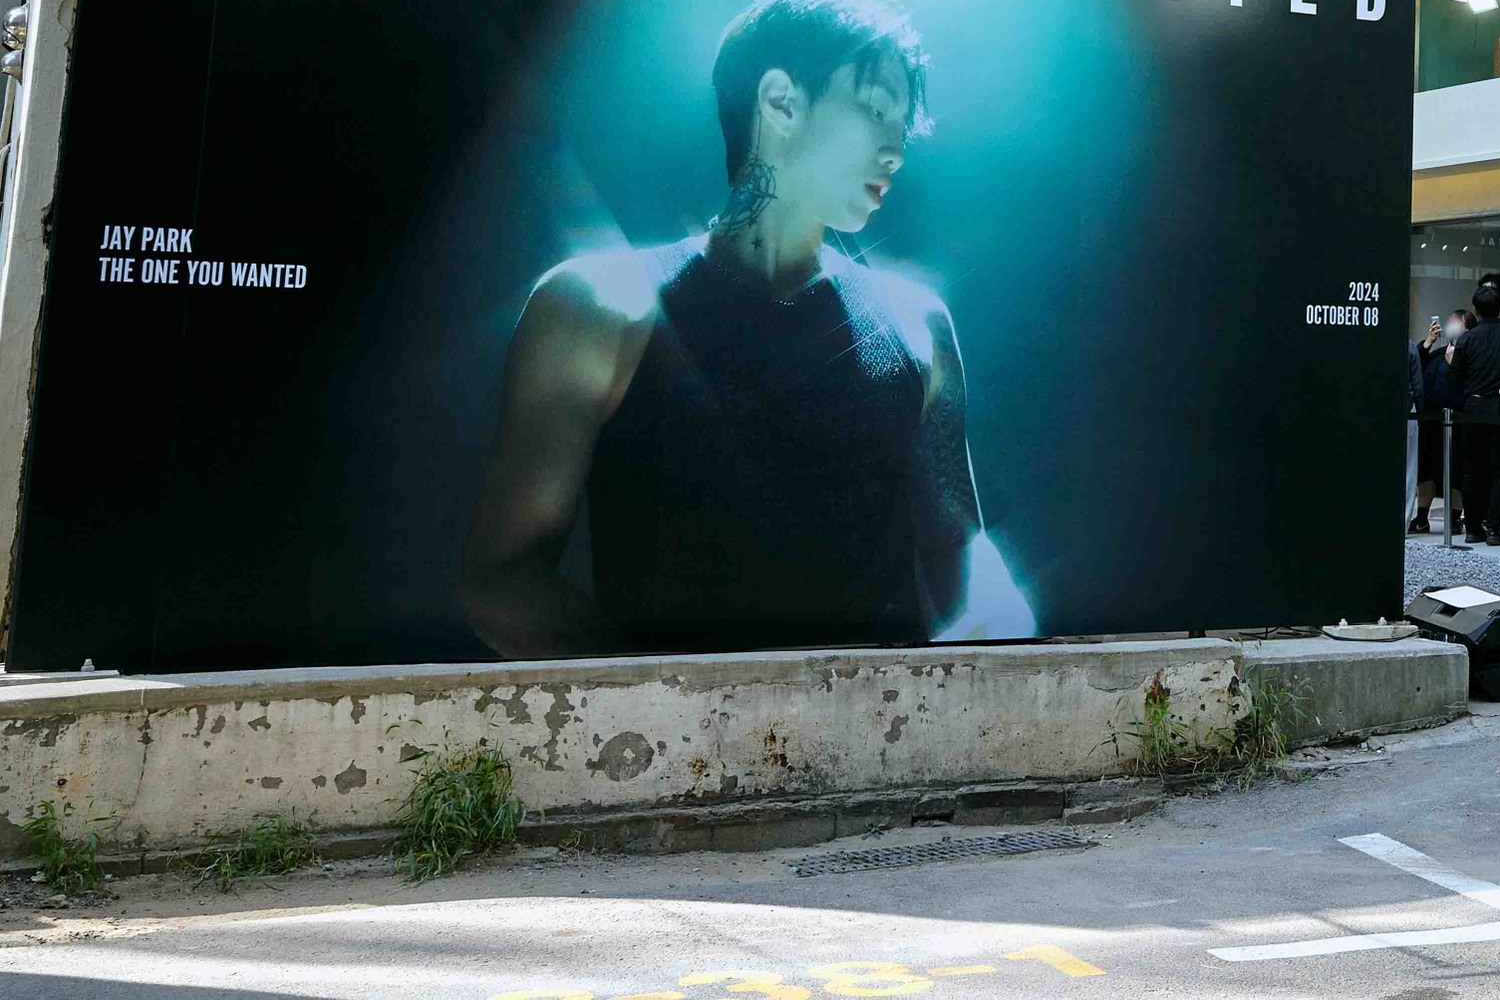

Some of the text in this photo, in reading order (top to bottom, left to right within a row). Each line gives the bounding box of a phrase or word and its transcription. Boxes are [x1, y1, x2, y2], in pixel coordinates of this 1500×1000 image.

[100, 225, 193, 253] JAY PARK
[99, 256, 308, 289] THE ONE YOU WANTED
[1348, 281, 1379, 302] 2024
[1306, 304, 1379, 327] OCTOBER 08
